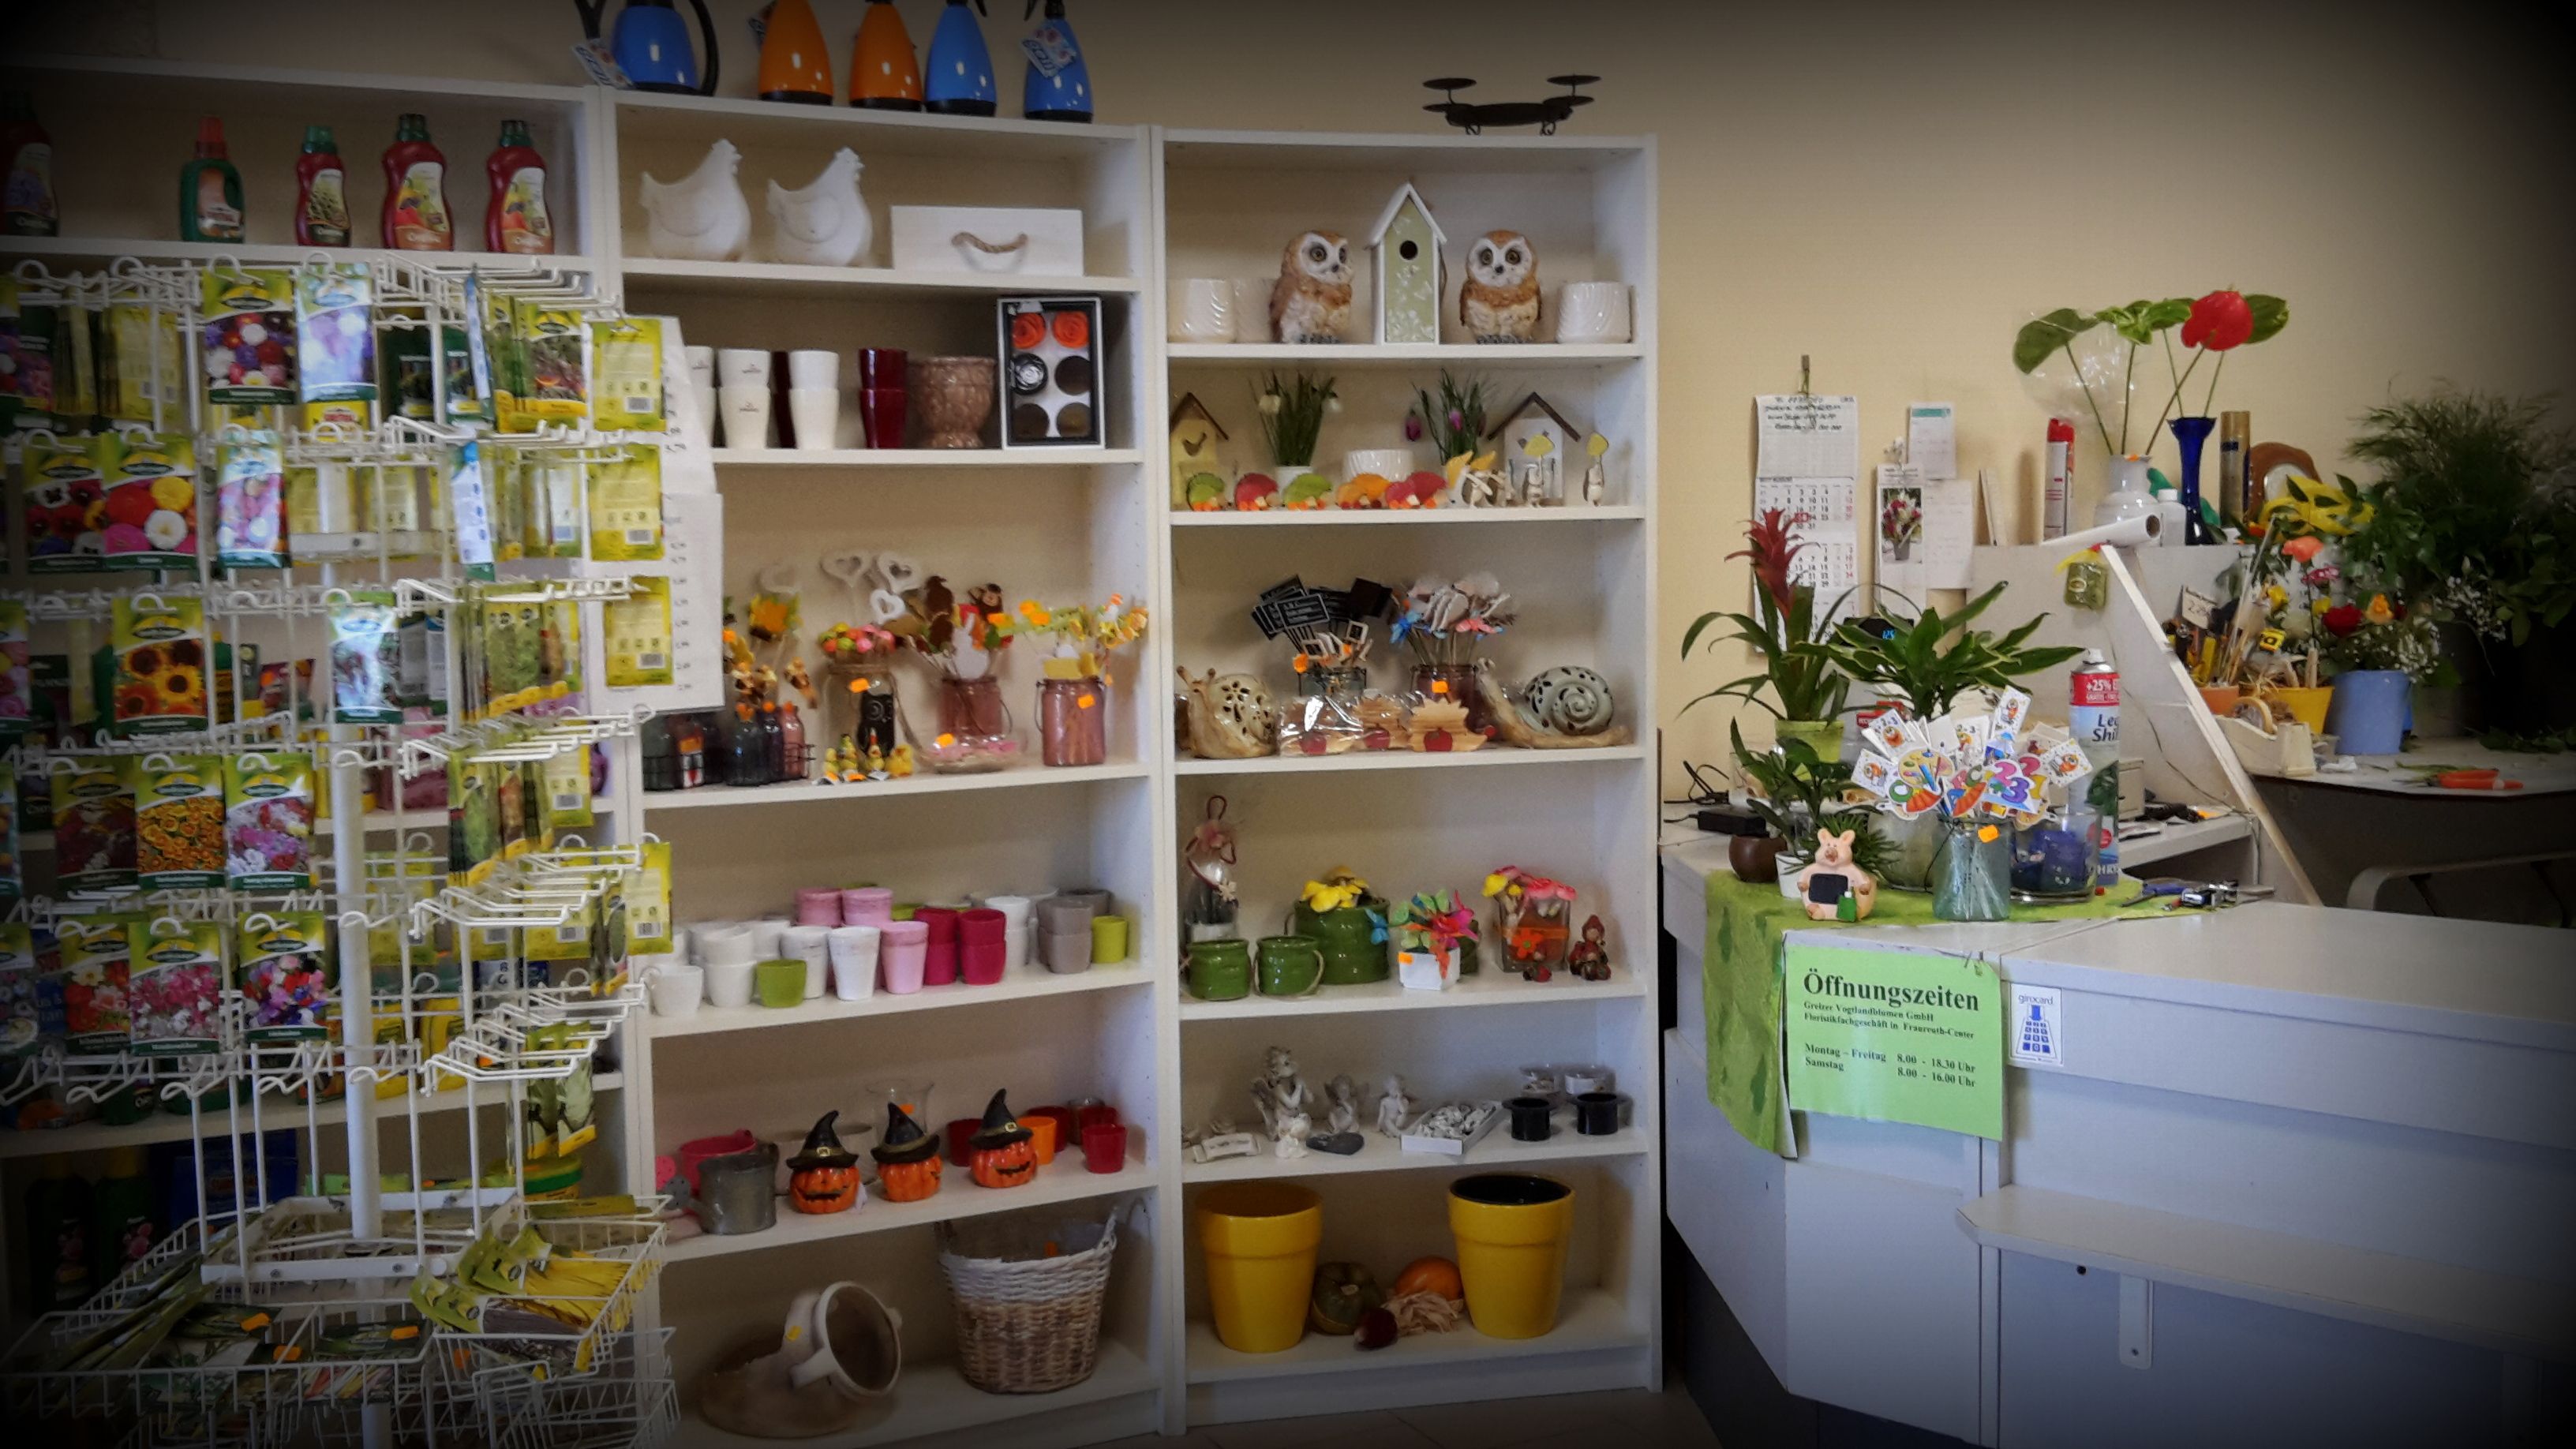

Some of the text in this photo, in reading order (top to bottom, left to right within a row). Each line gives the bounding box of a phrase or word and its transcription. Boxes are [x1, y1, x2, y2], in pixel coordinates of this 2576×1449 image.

[1803, 968, 1979, 1011] Öffnungszeiten
[1836, 1003, 1904, 1019] Vogtlandblumen
[1906, 1012, 1934, 1022] GmbH
[1890, 1021, 1898, 1030] in
[1805, 1043, 1840, 1058] Montag
[1852, 1048, 1886, 1062] Freitag
[1896, 1053, 1917, 1064] 8.00
[1931, 1058, 1955, 1069] 18.30
[1958, 1061, 1975, 1073] Uhr
[1805, 1056, 1844, 1072] Samstag
[1897, 1066, 1918, 1078] 8.00
[1932, 1072, 1956, 1084] 16.00
[1958, 1075, 1975, 1088] Uhr
